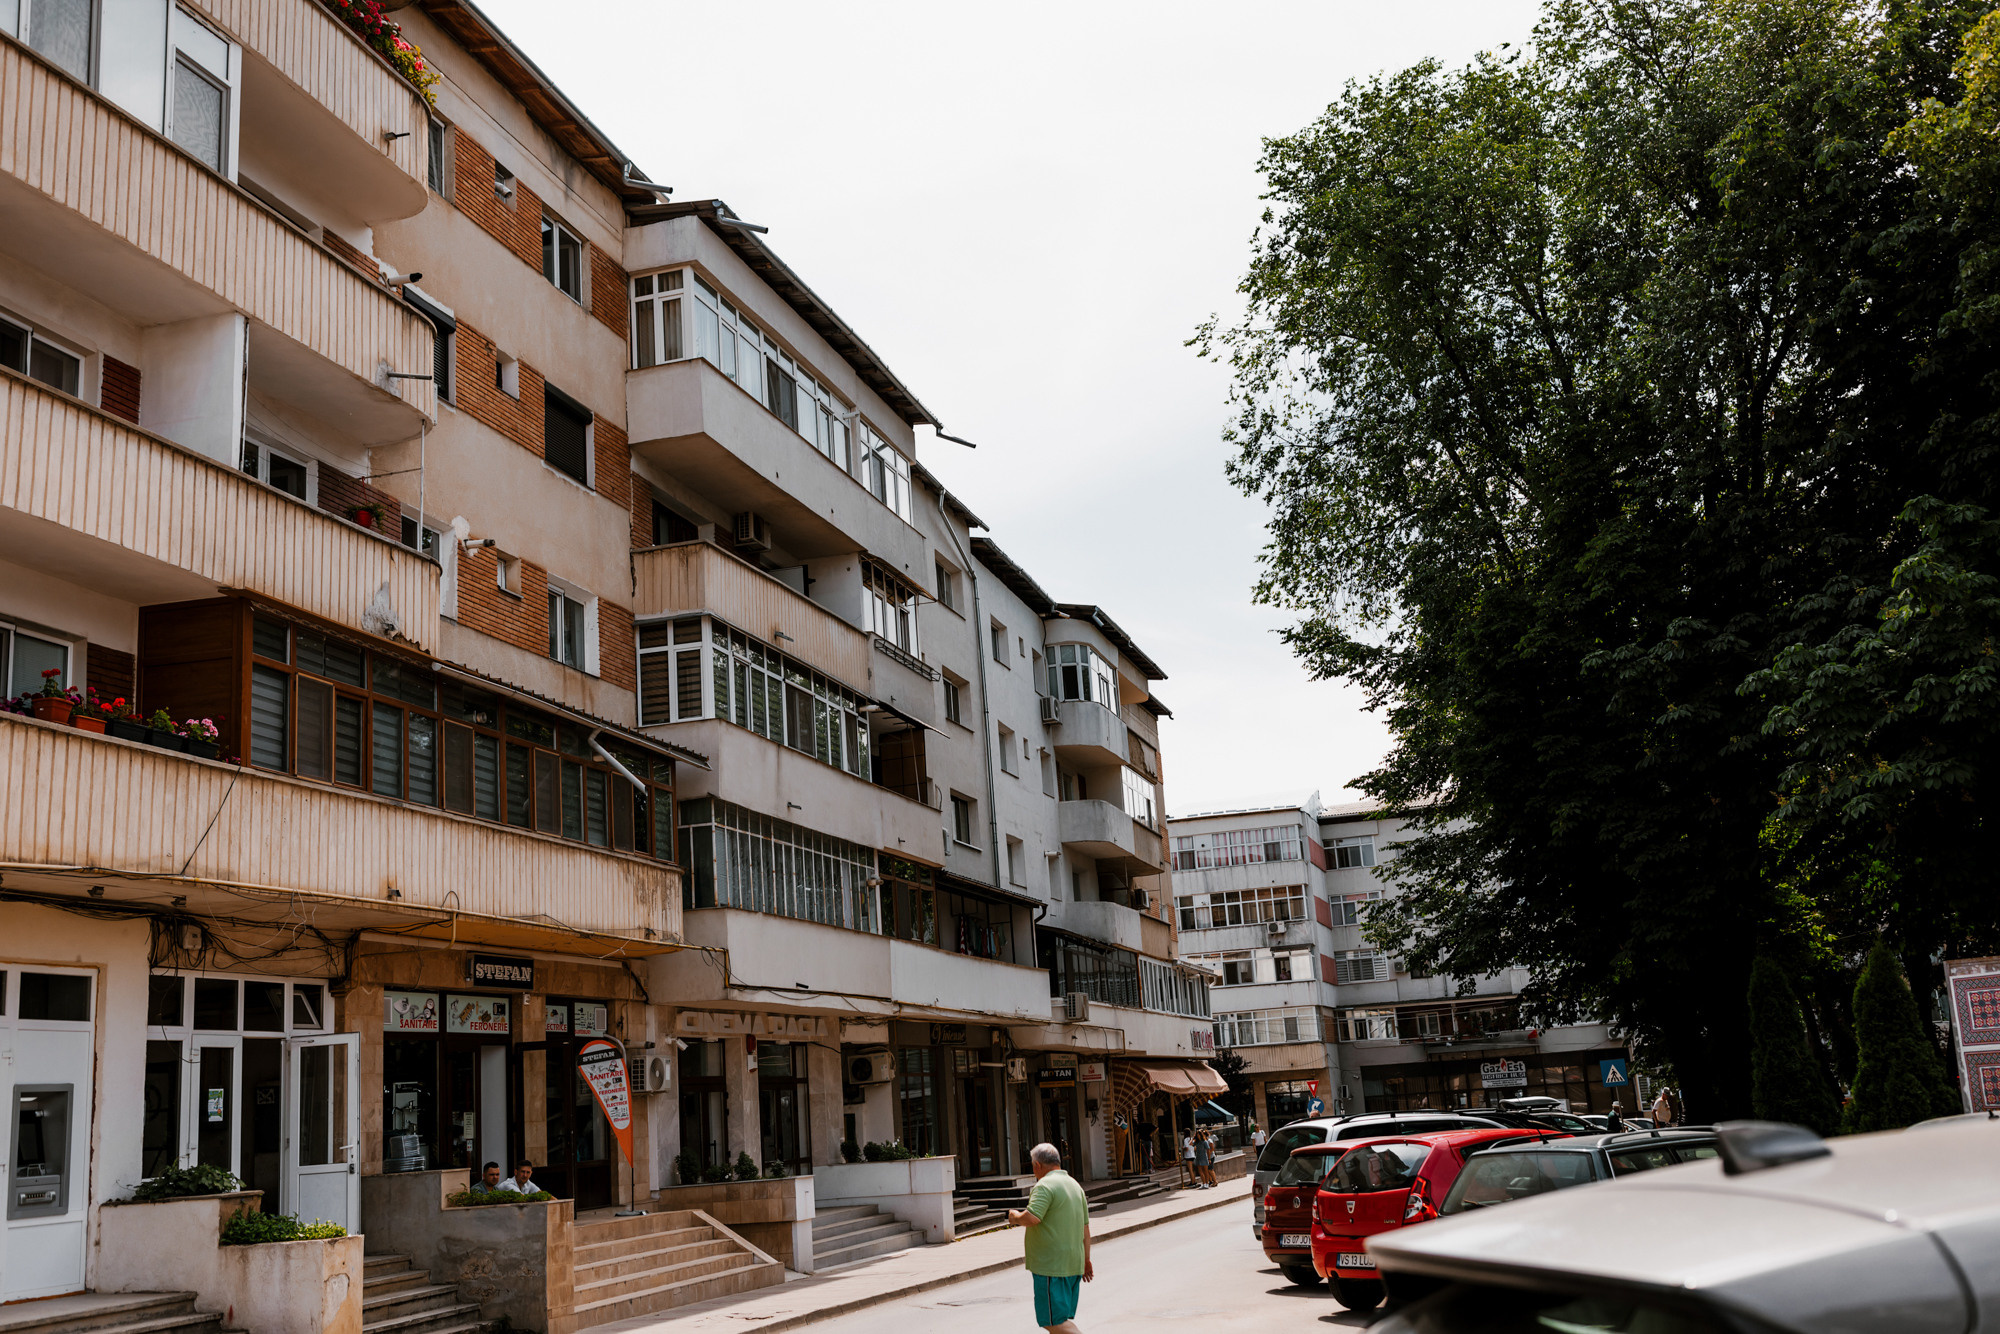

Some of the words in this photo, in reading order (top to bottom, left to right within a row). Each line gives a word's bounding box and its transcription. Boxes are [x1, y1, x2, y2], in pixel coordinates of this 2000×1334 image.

[475, 963, 532, 982] STEFAN
[399, 1018, 438, 1030] SANITARE
[469, 1021, 508, 1032] FERONERIE
[546, 1023, 567, 1031] ECTRICE
[678, 1010, 766, 1034] CINEMA
[768, 1016, 829, 1037] DACIA
[582, 1051, 615, 1062] STEFAN
[1482, 1063, 1501, 1073] Gaz
[1507, 1062, 1523, 1071] Est
[589, 1070, 624, 1081] SANITARE
[598, 1086, 626, 1096] FERONERIE
[1283, 1235, 1291, 1244] VS
[1292, 1235, 1299, 1244] 07
[1340, 1255, 1350, 1265] VS
[1351, 1256, 1358, 1265] 13
